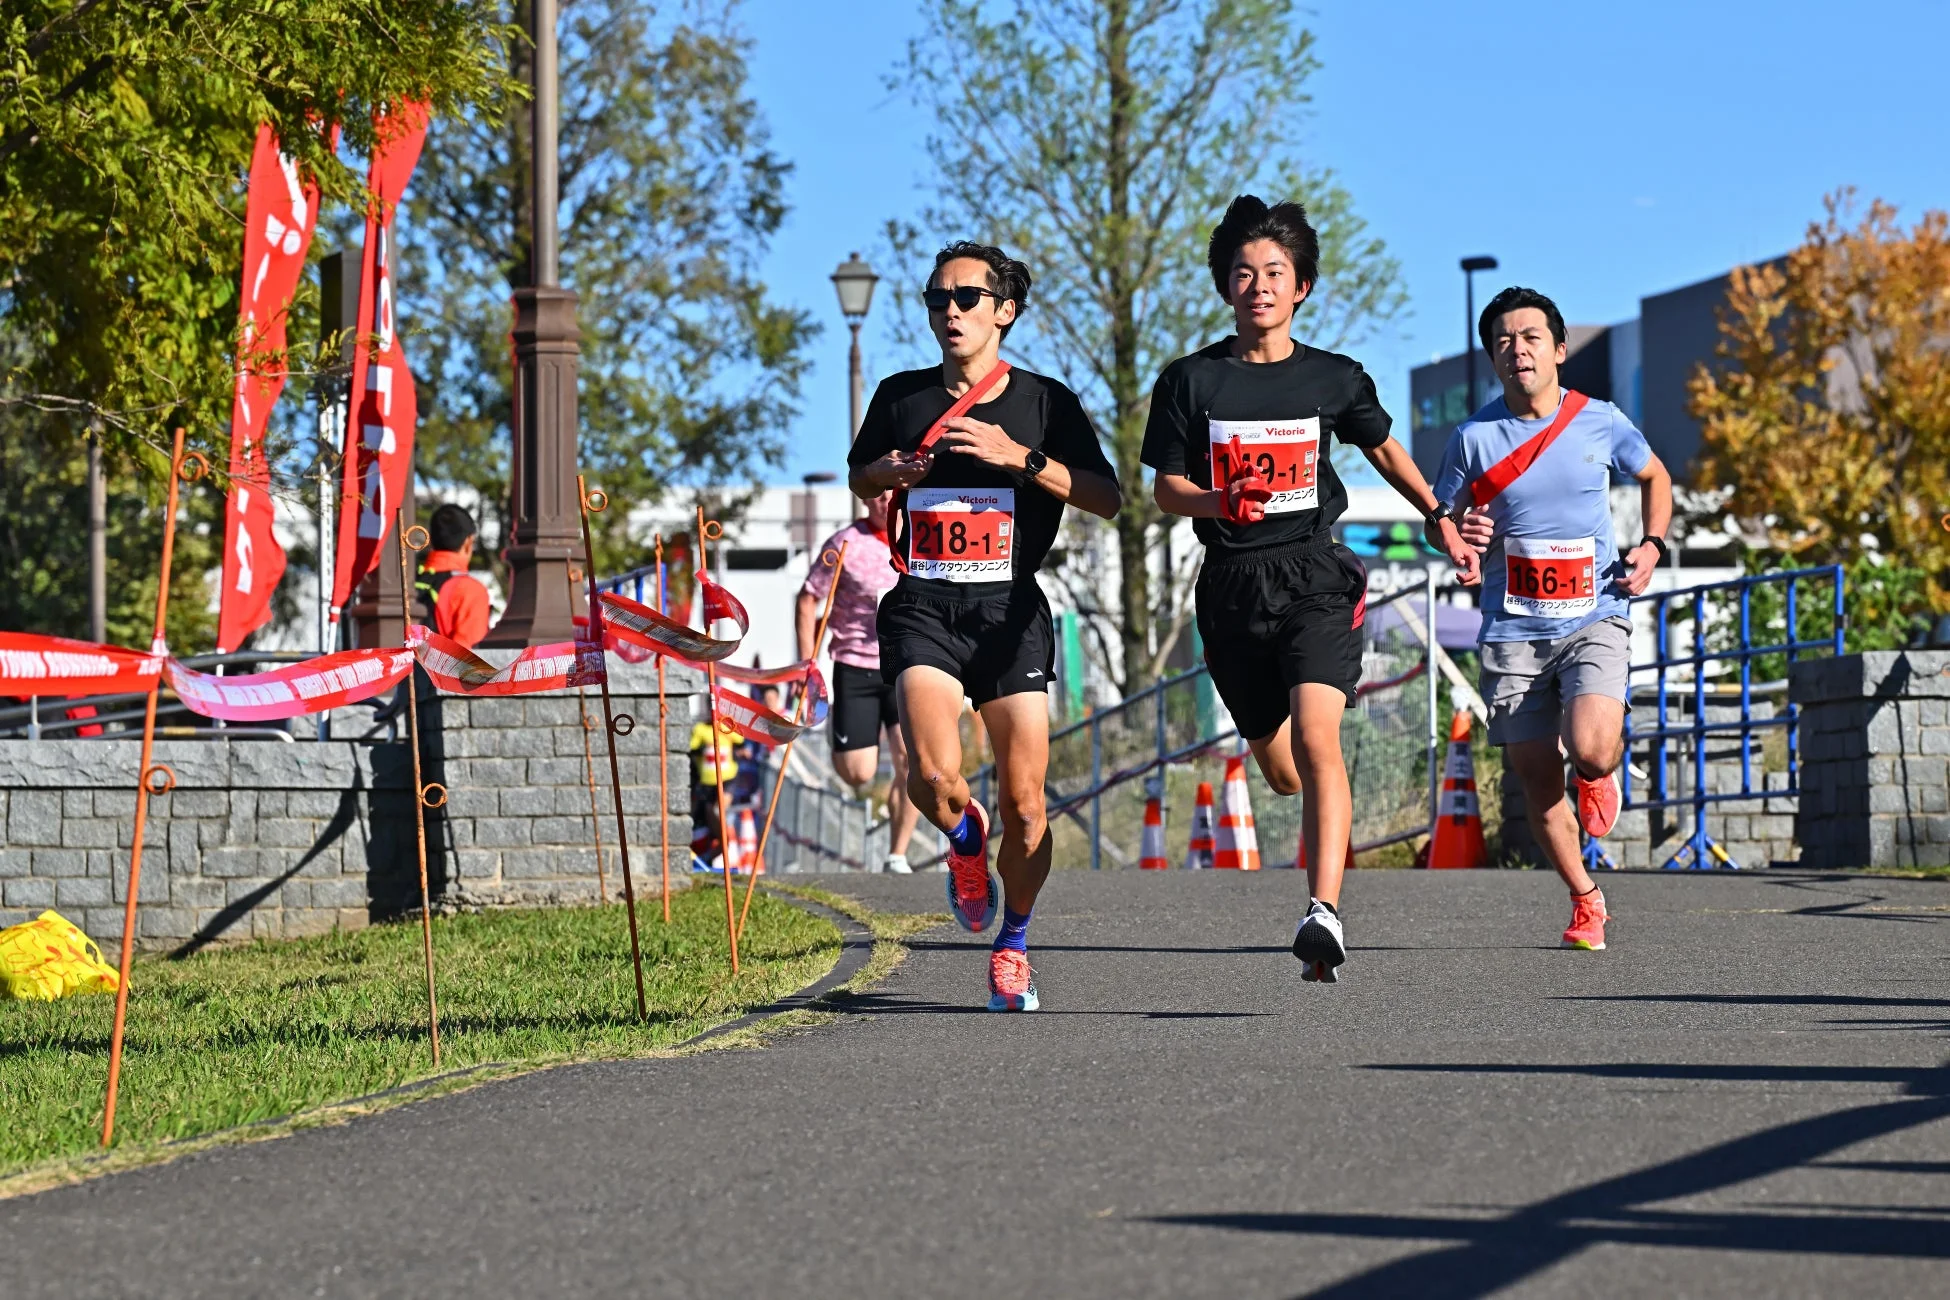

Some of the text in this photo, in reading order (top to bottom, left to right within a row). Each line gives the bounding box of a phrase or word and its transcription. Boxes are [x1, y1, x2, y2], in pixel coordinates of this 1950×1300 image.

[1265, 427, 1305, 437] Victoria
[958, 495, 998, 504] Victoria
[916, 521, 991, 555] 218-1
[1550, 545, 1583, 553] Victoria
[911, 561, 1010, 572] 越谷レイクタウンランニング
[1513, 564, 1577, 595] 166-1
[1507, 596, 1594, 609] 越谷レイクタウンランニング
